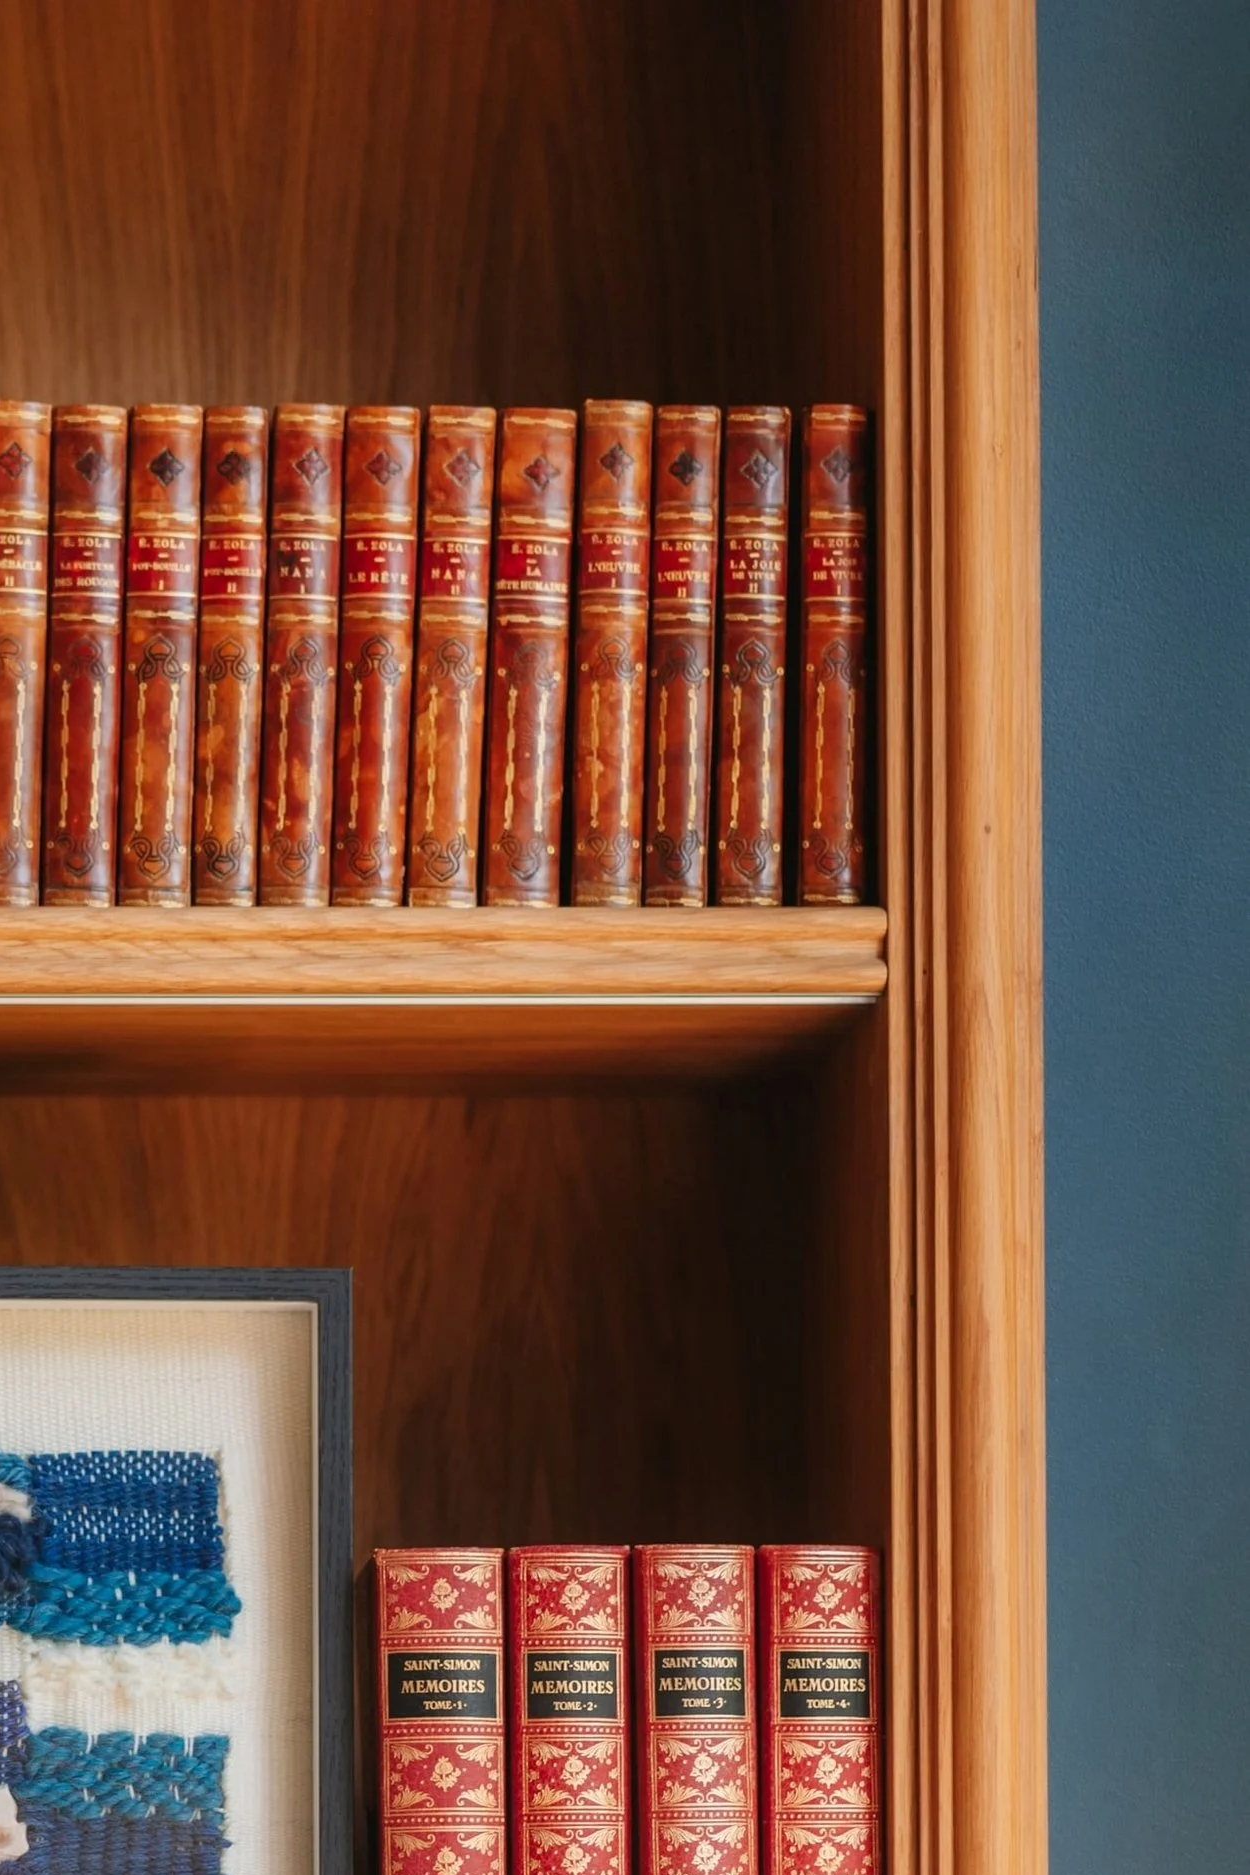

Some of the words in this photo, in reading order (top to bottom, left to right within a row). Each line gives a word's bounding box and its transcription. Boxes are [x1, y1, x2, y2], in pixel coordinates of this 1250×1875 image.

[0, 535, 32, 545] ZOLA
[78, 538, 111, 549] ZOLA
[153, 538, 186, 550] ZOLA
[223, 540, 255, 550] ZOLA
[606, 534, 638, 546] ZOLA
[744, 539, 779, 552] ZOLA
[828, 538, 860, 549] ZOLA
[371, 541, 404, 553] ZOLA
[526, 544, 559, 556] ZOLA
[675, 542, 709, 552] ZOLA
[404, 1659, 481, 1671] SAINT-SIMON
[534, 1660, 610, 1672] SAINT-SIMON
[662, 1657, 737, 1669] SAINT-SIMON
[787, 1658, 861, 1670] SAINT-SIMON
[401, 1679, 485, 1694] MEMOIRES
[530, 1680, 614, 1694] MEMOIRES
[658, 1677, 742, 1691] MEMOIRES
[783, 1677, 865, 1692] MEMOIRES
